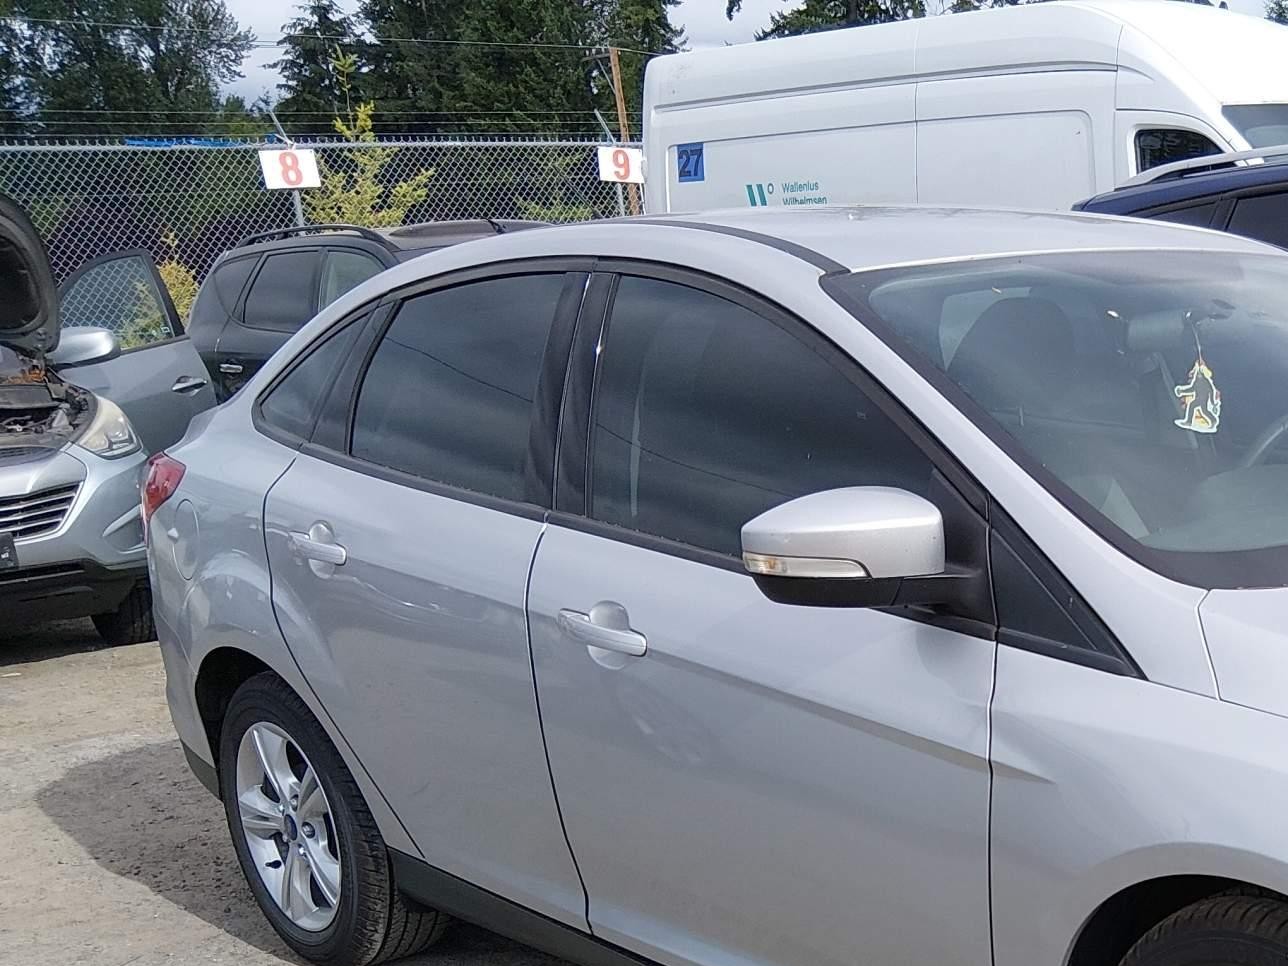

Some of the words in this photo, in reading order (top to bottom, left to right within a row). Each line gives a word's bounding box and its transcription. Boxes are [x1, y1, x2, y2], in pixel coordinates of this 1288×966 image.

[279, 151, 304, 186] 8
[612, 149, 631, 180] 9
[679, 148, 704, 177] 27
[781, 181, 819, 193] Wallenius
[782, 196, 828, 206] Wilhelmsen
